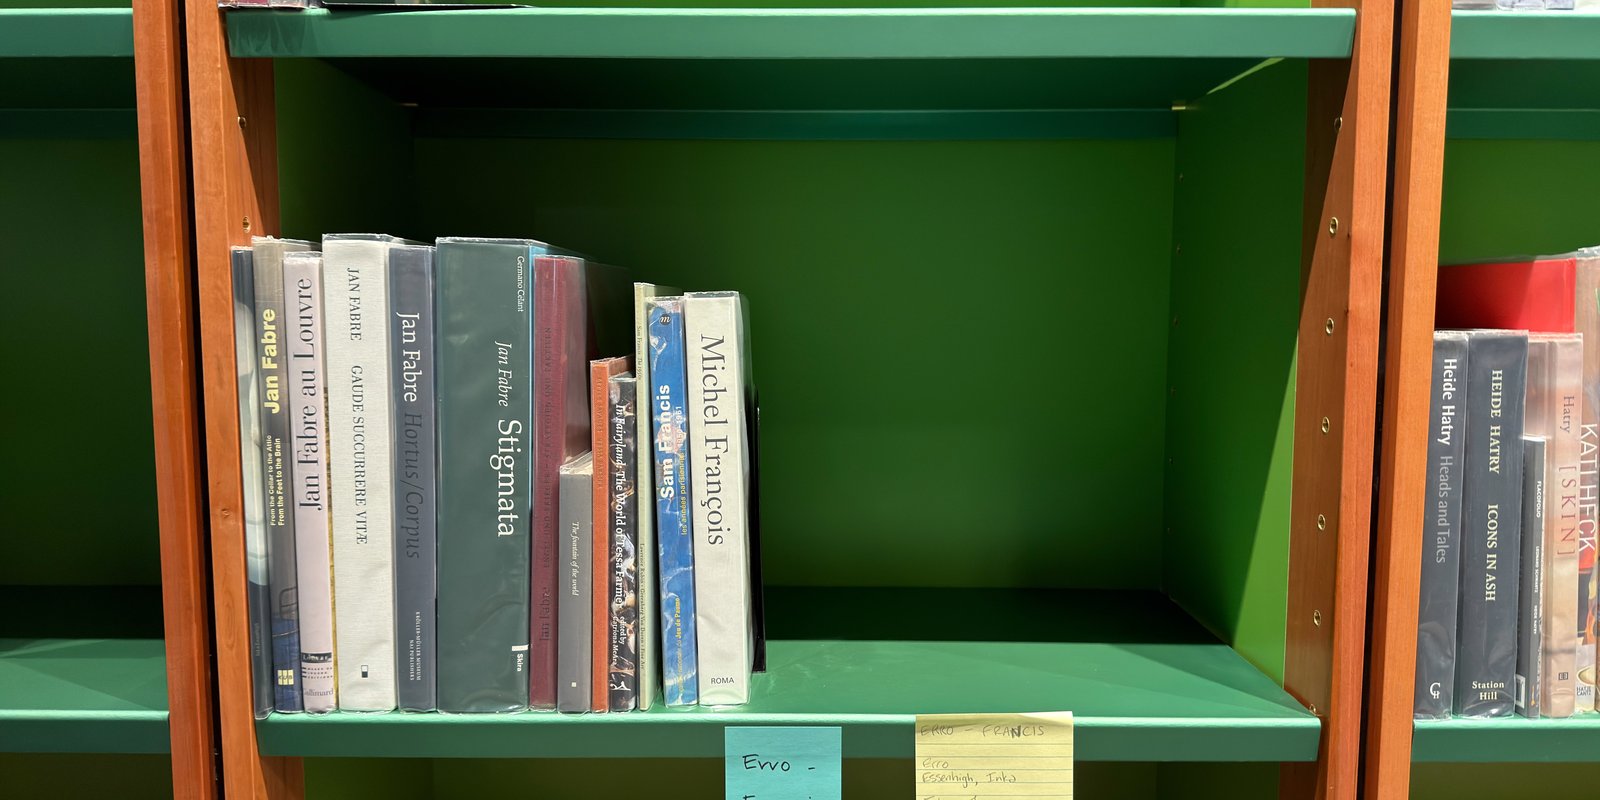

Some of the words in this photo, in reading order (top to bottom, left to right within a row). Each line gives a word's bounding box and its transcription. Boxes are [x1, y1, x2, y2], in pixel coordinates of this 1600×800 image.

[346, 268, 360, 292] JAN
[516, 256, 525, 288] Germano
[517, 290, 525, 312] Celant
[293, 278, 315, 360] Louvre
[349, 296, 362, 341] FABRE
[396, 312, 420, 344] Jan
[260, 308, 278, 369] Fabre
[494, 341, 513, 364] Jan
[301, 368, 316, 396] au
[350, 365, 364, 412] GAUDE
[402, 350, 423, 402] Fabre
[498, 368, 513, 407] Fabre
[700, 334, 728, 426] Michel
[1442, 359, 1458, 400] Heide
[264, 376, 280, 414] Jan
[616, 404, 624, 416] In
[1490, 370, 1502, 418] HEIDE
[656, 384, 673, 452] Francis
[1437, 405, 1455, 446] Hatry
[1560, 396, 1575, 434] Hatry
[274, 438, 282, 457] Brain
[296, 405, 319, 466] Fabre
[613, 418, 626, 469] Fairyland:
[1488, 426, 1501, 474] HATRY
[1580, 424, 1598, 475] KATI
[276, 470, 282, 478] to
[352, 416, 367, 506] SUCCURRERE
[1438, 456, 1453, 498] Heads
[276, 478, 284, 494] Feet
[299, 474, 322, 511] Jan
[400, 413, 425, 559] Hortus/Corpus
[490, 420, 523, 537] Stigmata
[616, 470, 626, 490] The
[660, 458, 674, 498] Sam
[700, 435, 730, 545] François
[616, 492, 626, 526] World
[1437, 500, 1450, 526] and
[355, 511, 368, 544] VITÆ
[572, 522, 580, 534] The
[616, 528, 626, 540] of
[1486, 504, 1498, 548] ICONS
[570, 534, 580, 560] fountain
[616, 540, 625, 569] Tessa
[1436, 530, 1450, 564] Tales
[1486, 554, 1497, 570] IN
[570, 560, 580, 568] of
[572, 568, 580, 578] the
[572, 579, 580, 596] world
[616, 570, 625, 608] Farmer
[1485, 574, 1497, 601] ASH
[674, 618, 681, 626] de
[618, 636, 626, 644] by
[516, 654, 524, 672] Skira
[1472, 680, 1505, 689] Station
[1479, 692, 1498, 700] Hill
[920, 726, 954, 736] ERRO
[982, 724, 1045, 738] FRANCIS
[922, 758, 949, 769] Erro
[922, 772, 978, 788] Essenhigh,
[986, 773, 1016, 783] Inka
